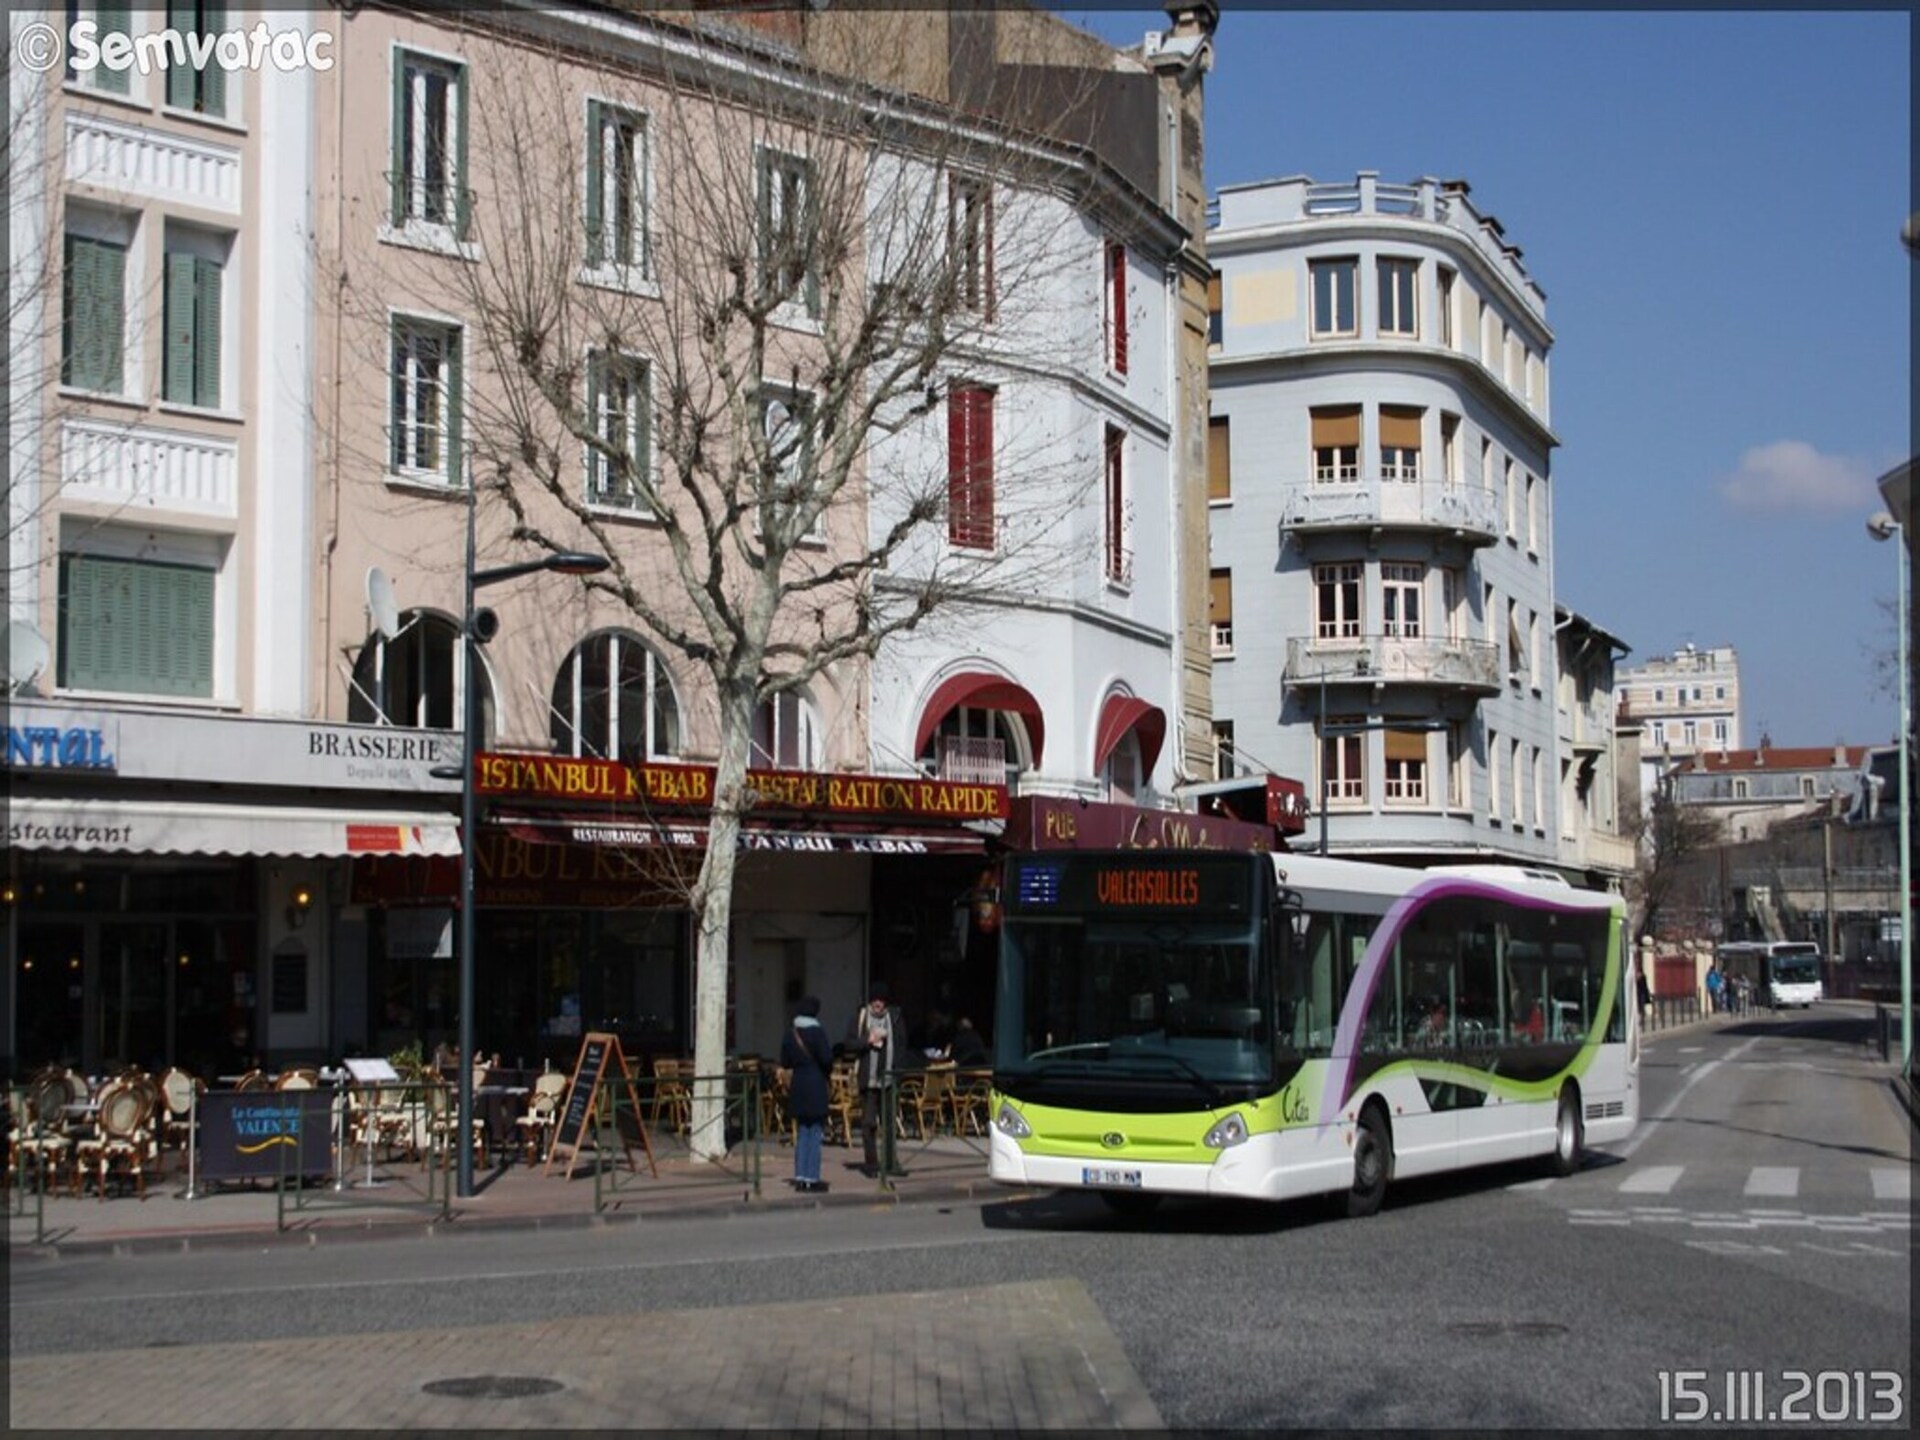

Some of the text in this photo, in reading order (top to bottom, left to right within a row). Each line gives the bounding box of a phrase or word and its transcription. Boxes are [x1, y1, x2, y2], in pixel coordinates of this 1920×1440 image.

[6, 726, 115, 768] NTAL
[309, 731, 441, 762] BRASSERIE
[480, 757, 708, 798] ISTANBUL KEBAB
[920, 786, 1000, 815] RAPIDE
[1046, 811, 1077, 840] PUB
[738, 834, 927, 853] TANBUL KEBAB
[1098, 870, 1199, 904] VALENSOLLES
[236, 1119, 300, 1135] VALENE
